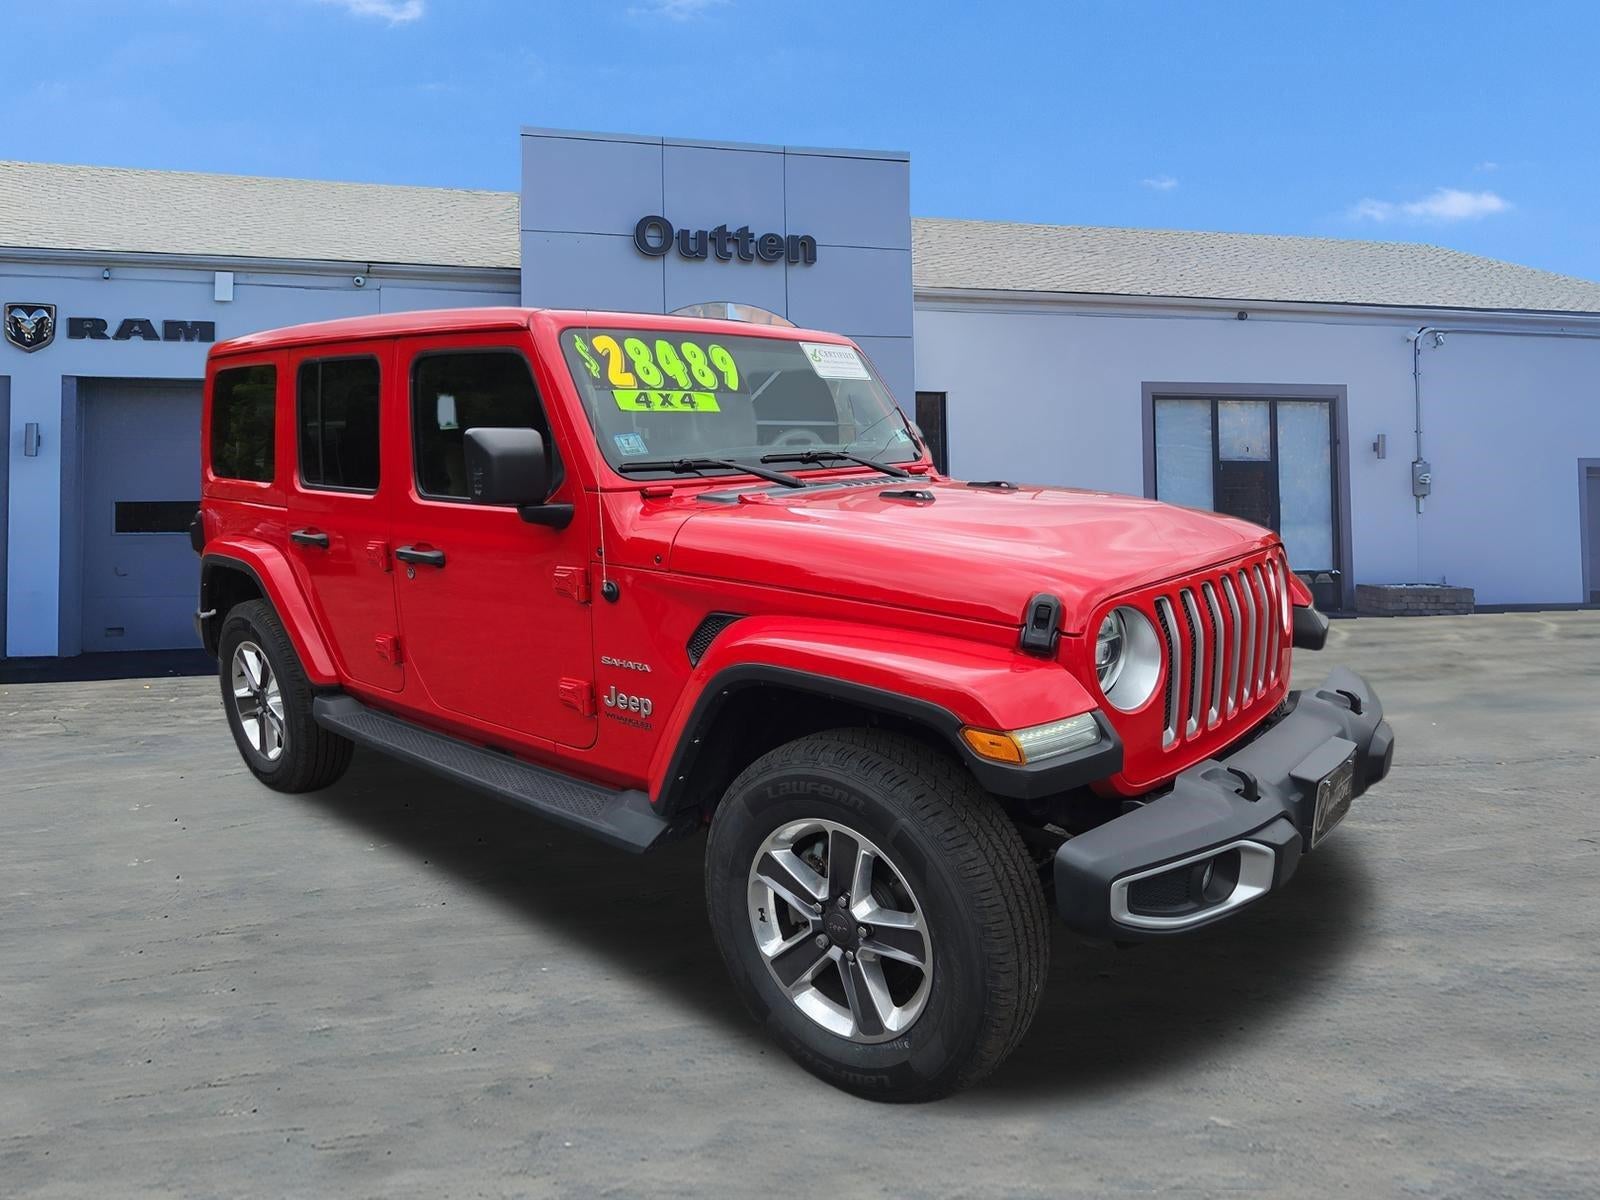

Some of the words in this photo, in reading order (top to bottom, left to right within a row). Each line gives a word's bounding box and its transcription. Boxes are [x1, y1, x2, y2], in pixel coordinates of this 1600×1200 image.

[634, 215, 817, 264] Outten
[66, 317, 215, 342] RAM
[601, 655, 652, 672] SAHARA
[603, 685, 652, 718] Jeep
